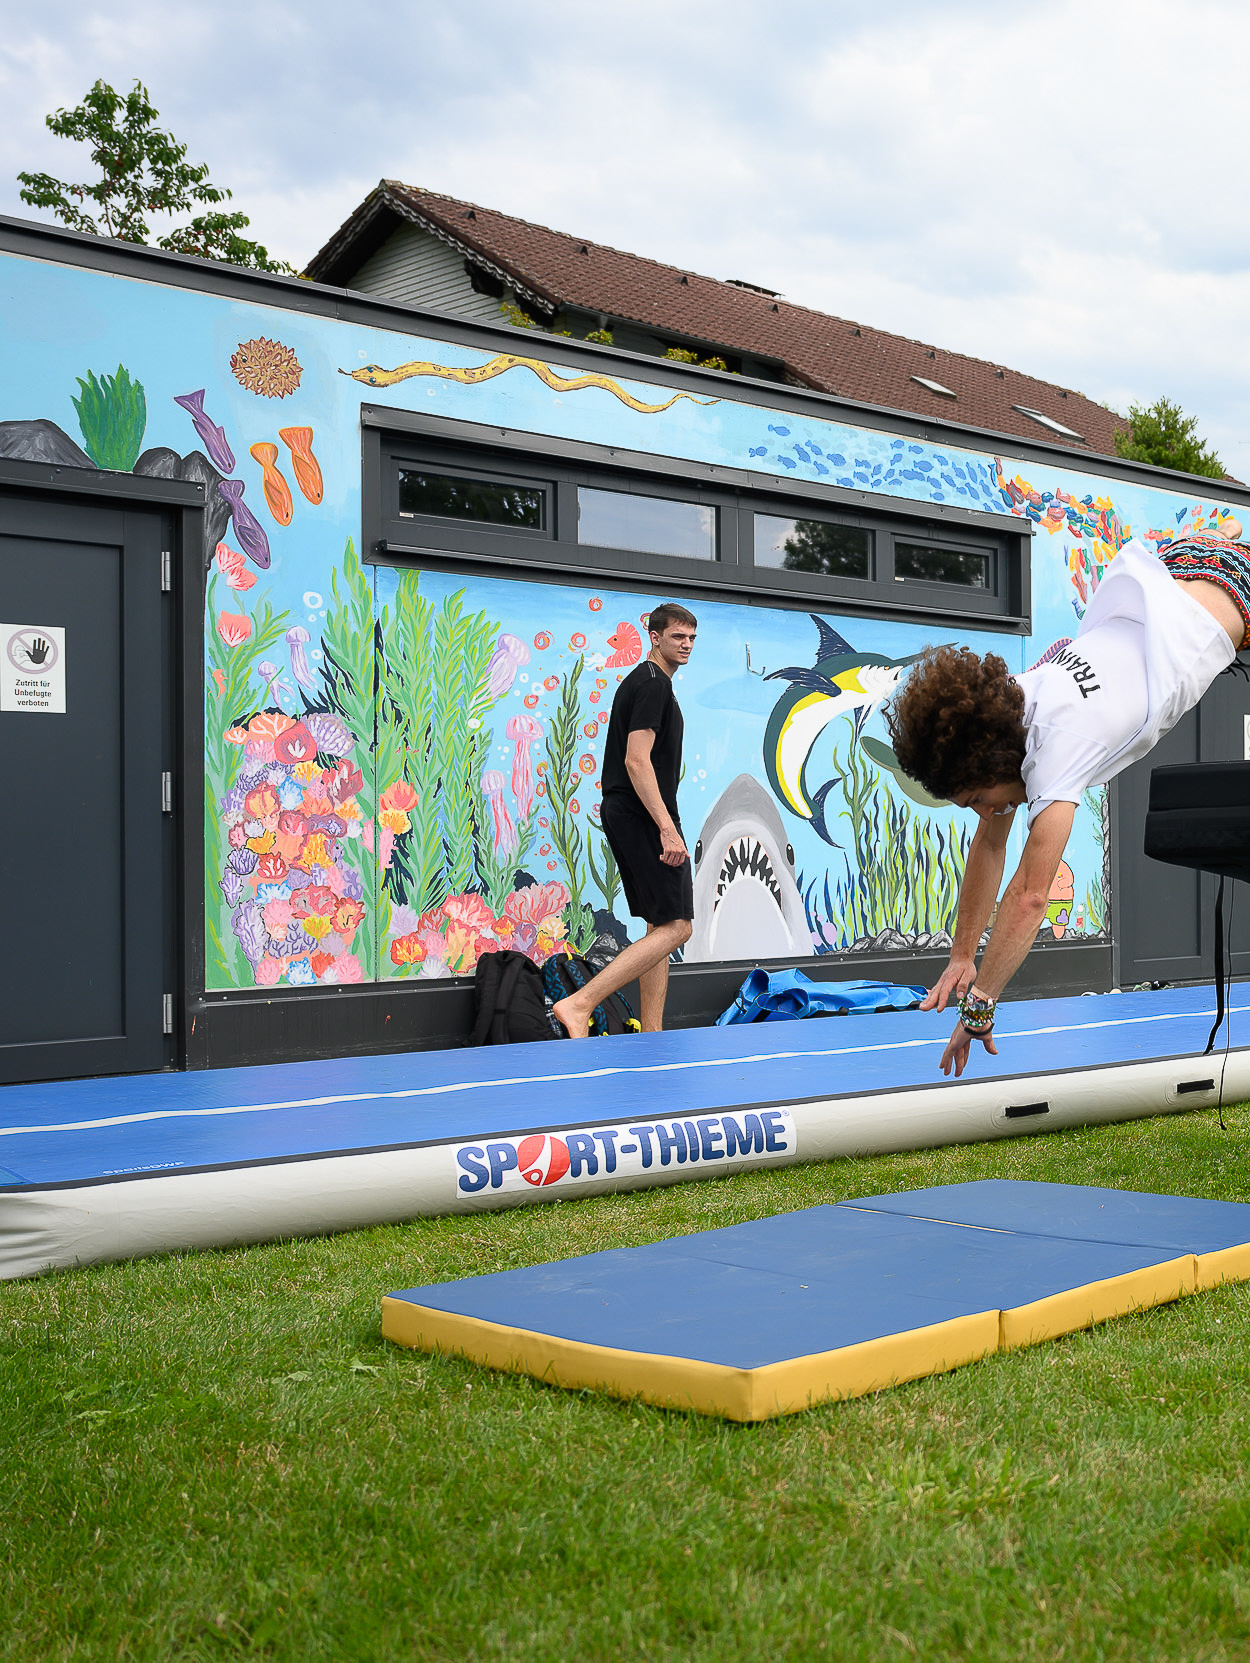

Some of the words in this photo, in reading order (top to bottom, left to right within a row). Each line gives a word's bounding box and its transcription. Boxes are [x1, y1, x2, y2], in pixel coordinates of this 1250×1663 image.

[1051, 648, 1101, 699] TRAIN
[15, 679, 39, 687] Zutritt
[14, 689, 52, 698] Unbefugte
